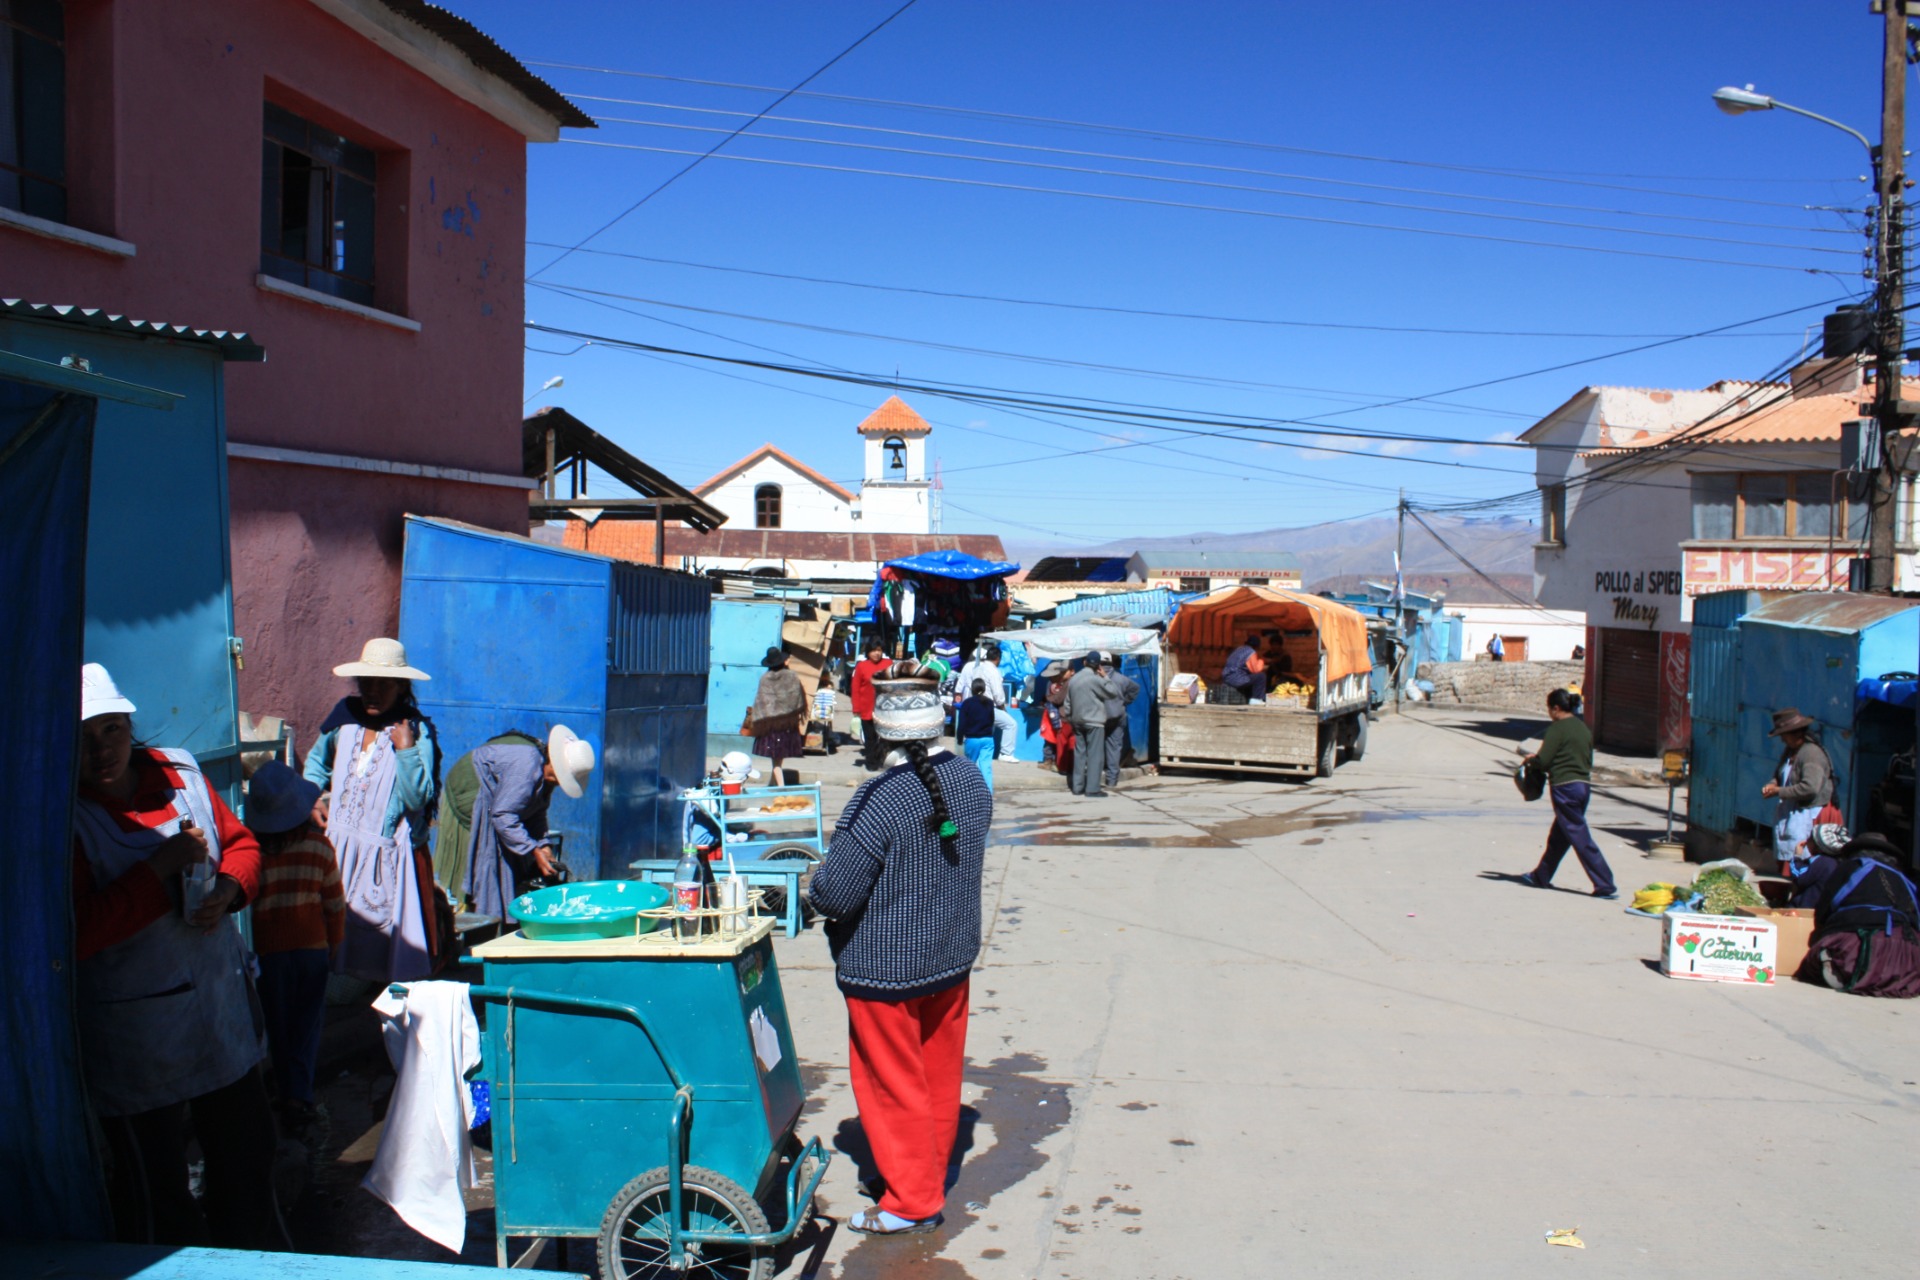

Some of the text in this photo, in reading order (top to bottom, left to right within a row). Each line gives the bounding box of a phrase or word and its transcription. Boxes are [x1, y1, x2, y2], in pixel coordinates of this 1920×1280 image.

[1161, 569, 1291, 578] KINDER CONCEPCION
[1596, 571, 1631, 593] POLLO
[1633, 571, 1644, 593] al
[1613, 596, 1659, 630] Mary
[1700, 937, 1763, 963] Caterina
